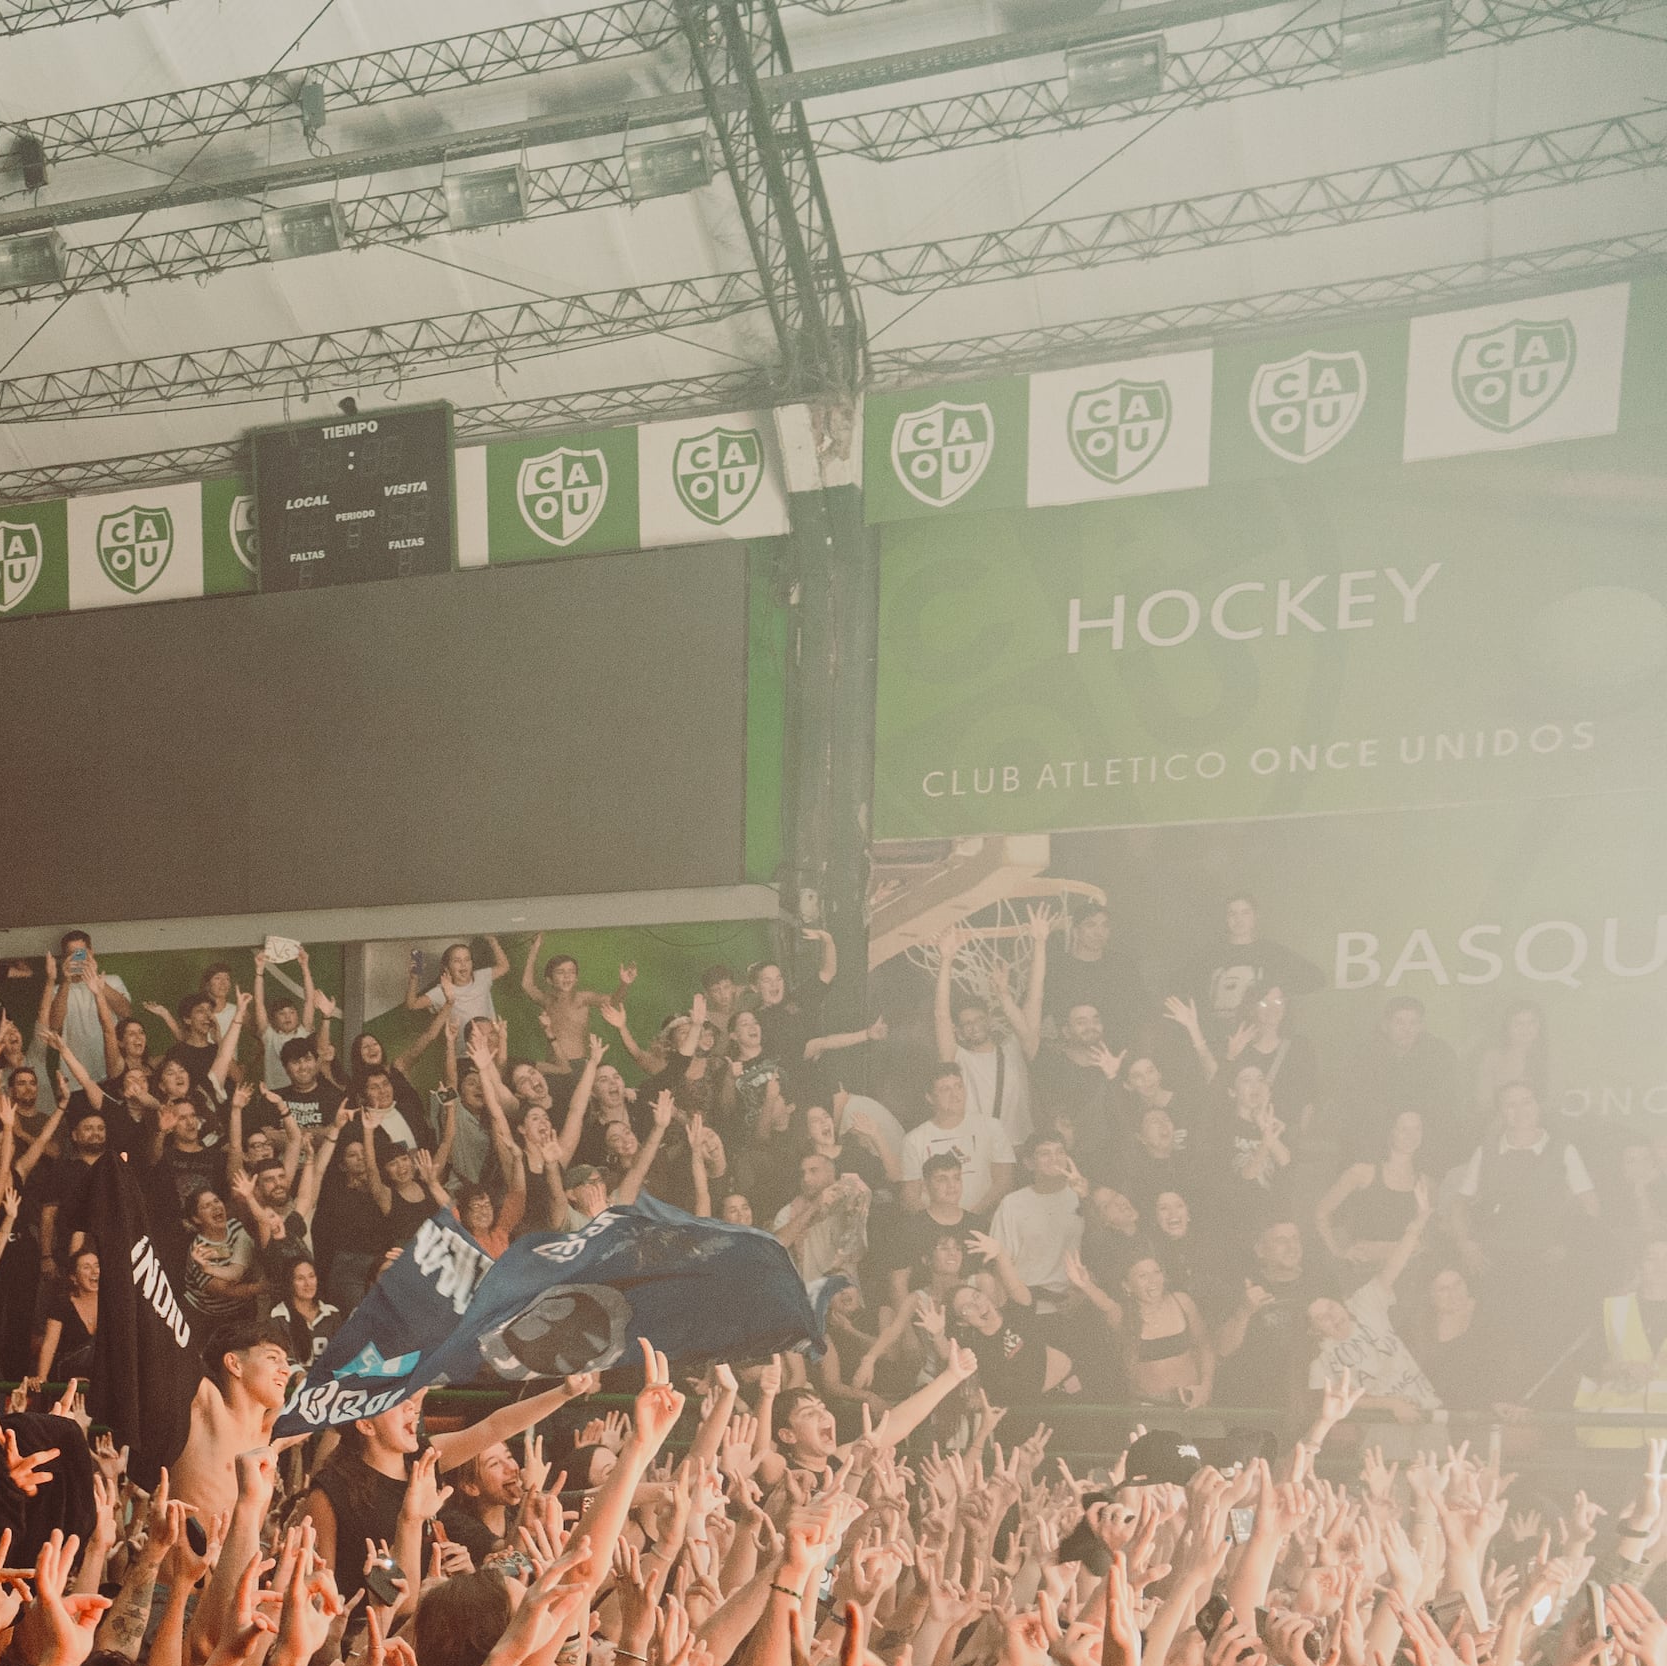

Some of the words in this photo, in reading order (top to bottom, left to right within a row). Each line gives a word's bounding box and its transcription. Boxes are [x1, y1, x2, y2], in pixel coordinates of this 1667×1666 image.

[322, 420, 378, 439] TIEMPO
[384, 481, 428, 497] VISITA
[285, 494, 330, 510] LOCAL
[335, 509, 375, 522] PERIODO
[388, 537, 425, 549] FALTAS
[290, 550, 325, 562] FALTAS
[1067, 562, 1444, 654] HOCKEY
[921, 765, 1021, 799] CLUB
[1037, 751, 1227, 790] ATLETICO
[1249, 737, 1379, 776] ONCE
[1399, 720, 1597, 765] UNIDOS
